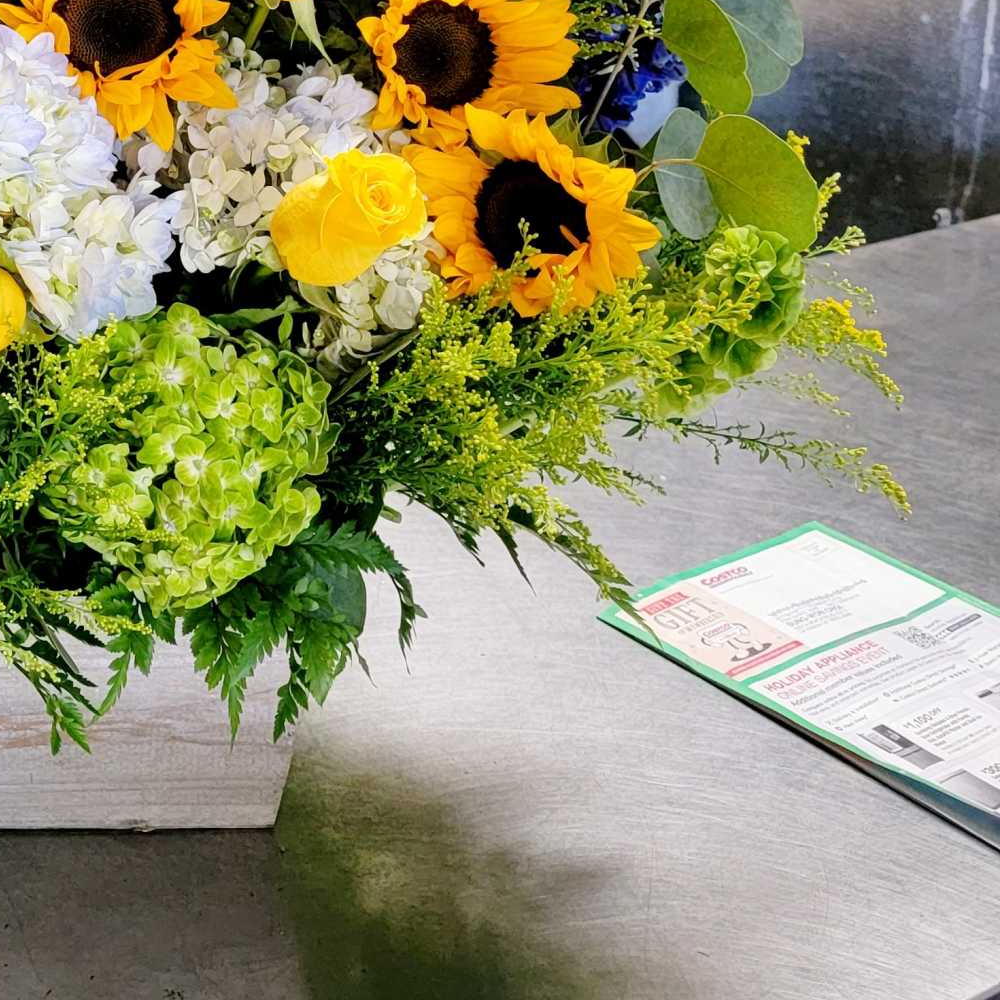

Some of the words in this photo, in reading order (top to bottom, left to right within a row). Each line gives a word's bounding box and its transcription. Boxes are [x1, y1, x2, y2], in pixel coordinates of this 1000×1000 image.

[700, 566, 748, 586] COSTCO
[654, 597, 716, 630] GIFT
[763, 666, 815, 693] HOLIDAY
[814, 639, 879, 671] APPLIANCE
[776, 680, 818, 700] ONLINE
[814, 661, 857, 682] SAVINGS
[856, 646, 888, 666] EVENT
